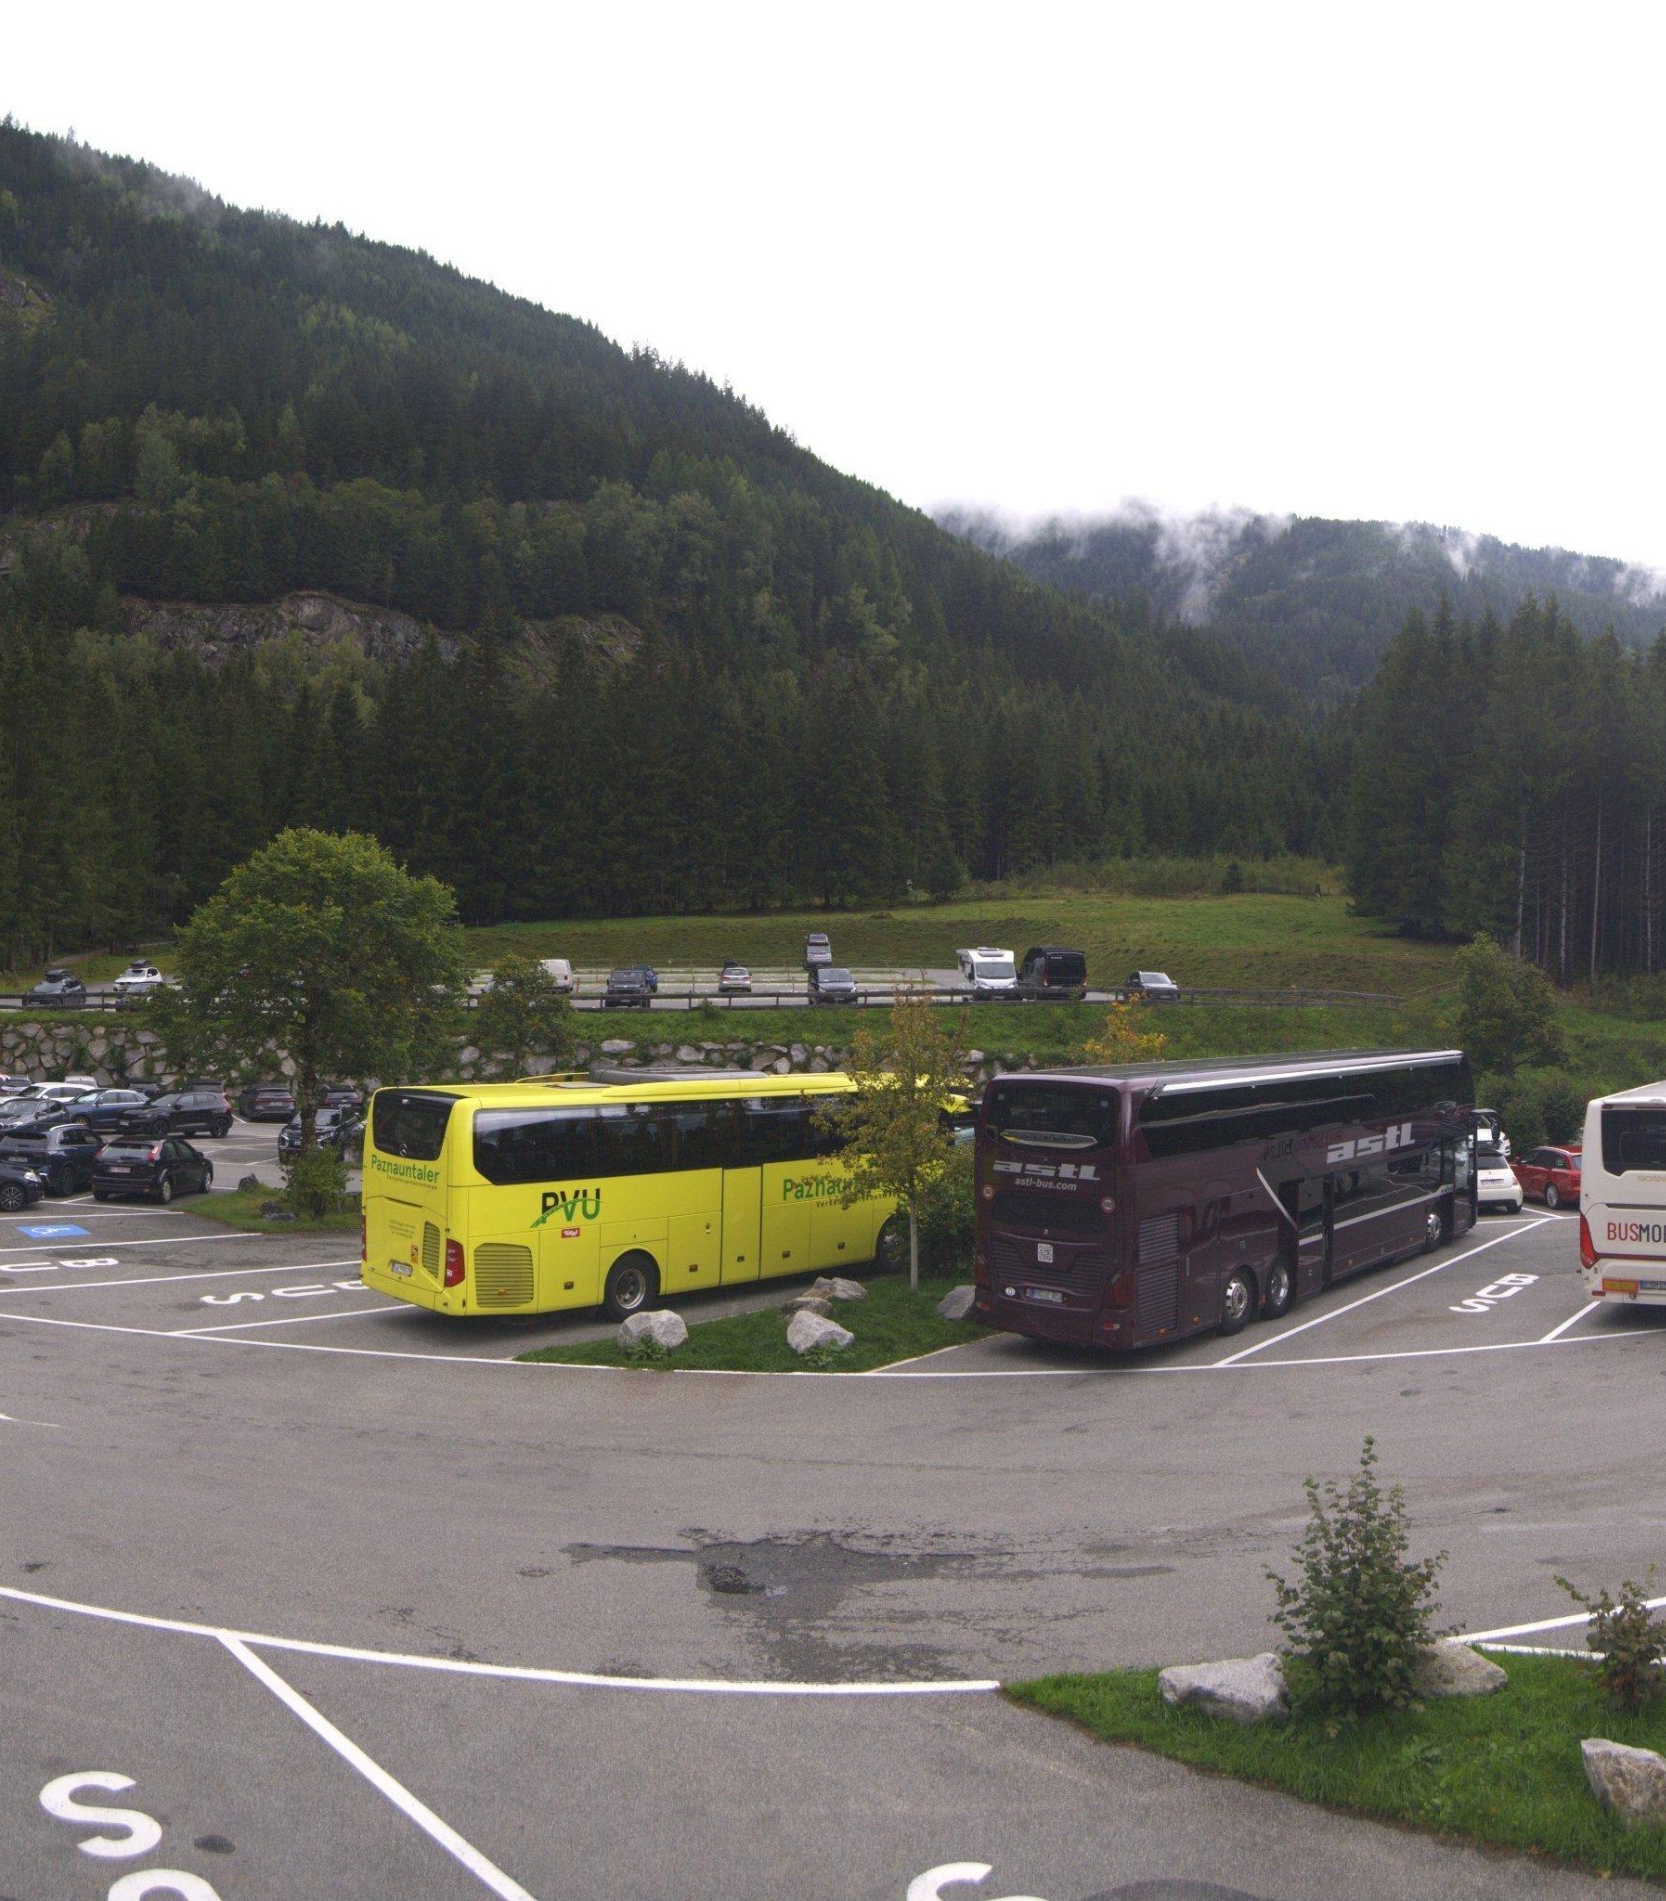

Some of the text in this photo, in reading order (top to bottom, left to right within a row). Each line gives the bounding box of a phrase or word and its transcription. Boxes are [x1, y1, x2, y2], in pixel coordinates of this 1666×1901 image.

[371, 1154, 440, 1183] Paznauntaler
[1014, 1176, 1078, 1191] astl-bus.com
[541, 1187, 601, 1223] PVU
[1448, 1273, 1539, 1313] BUS
